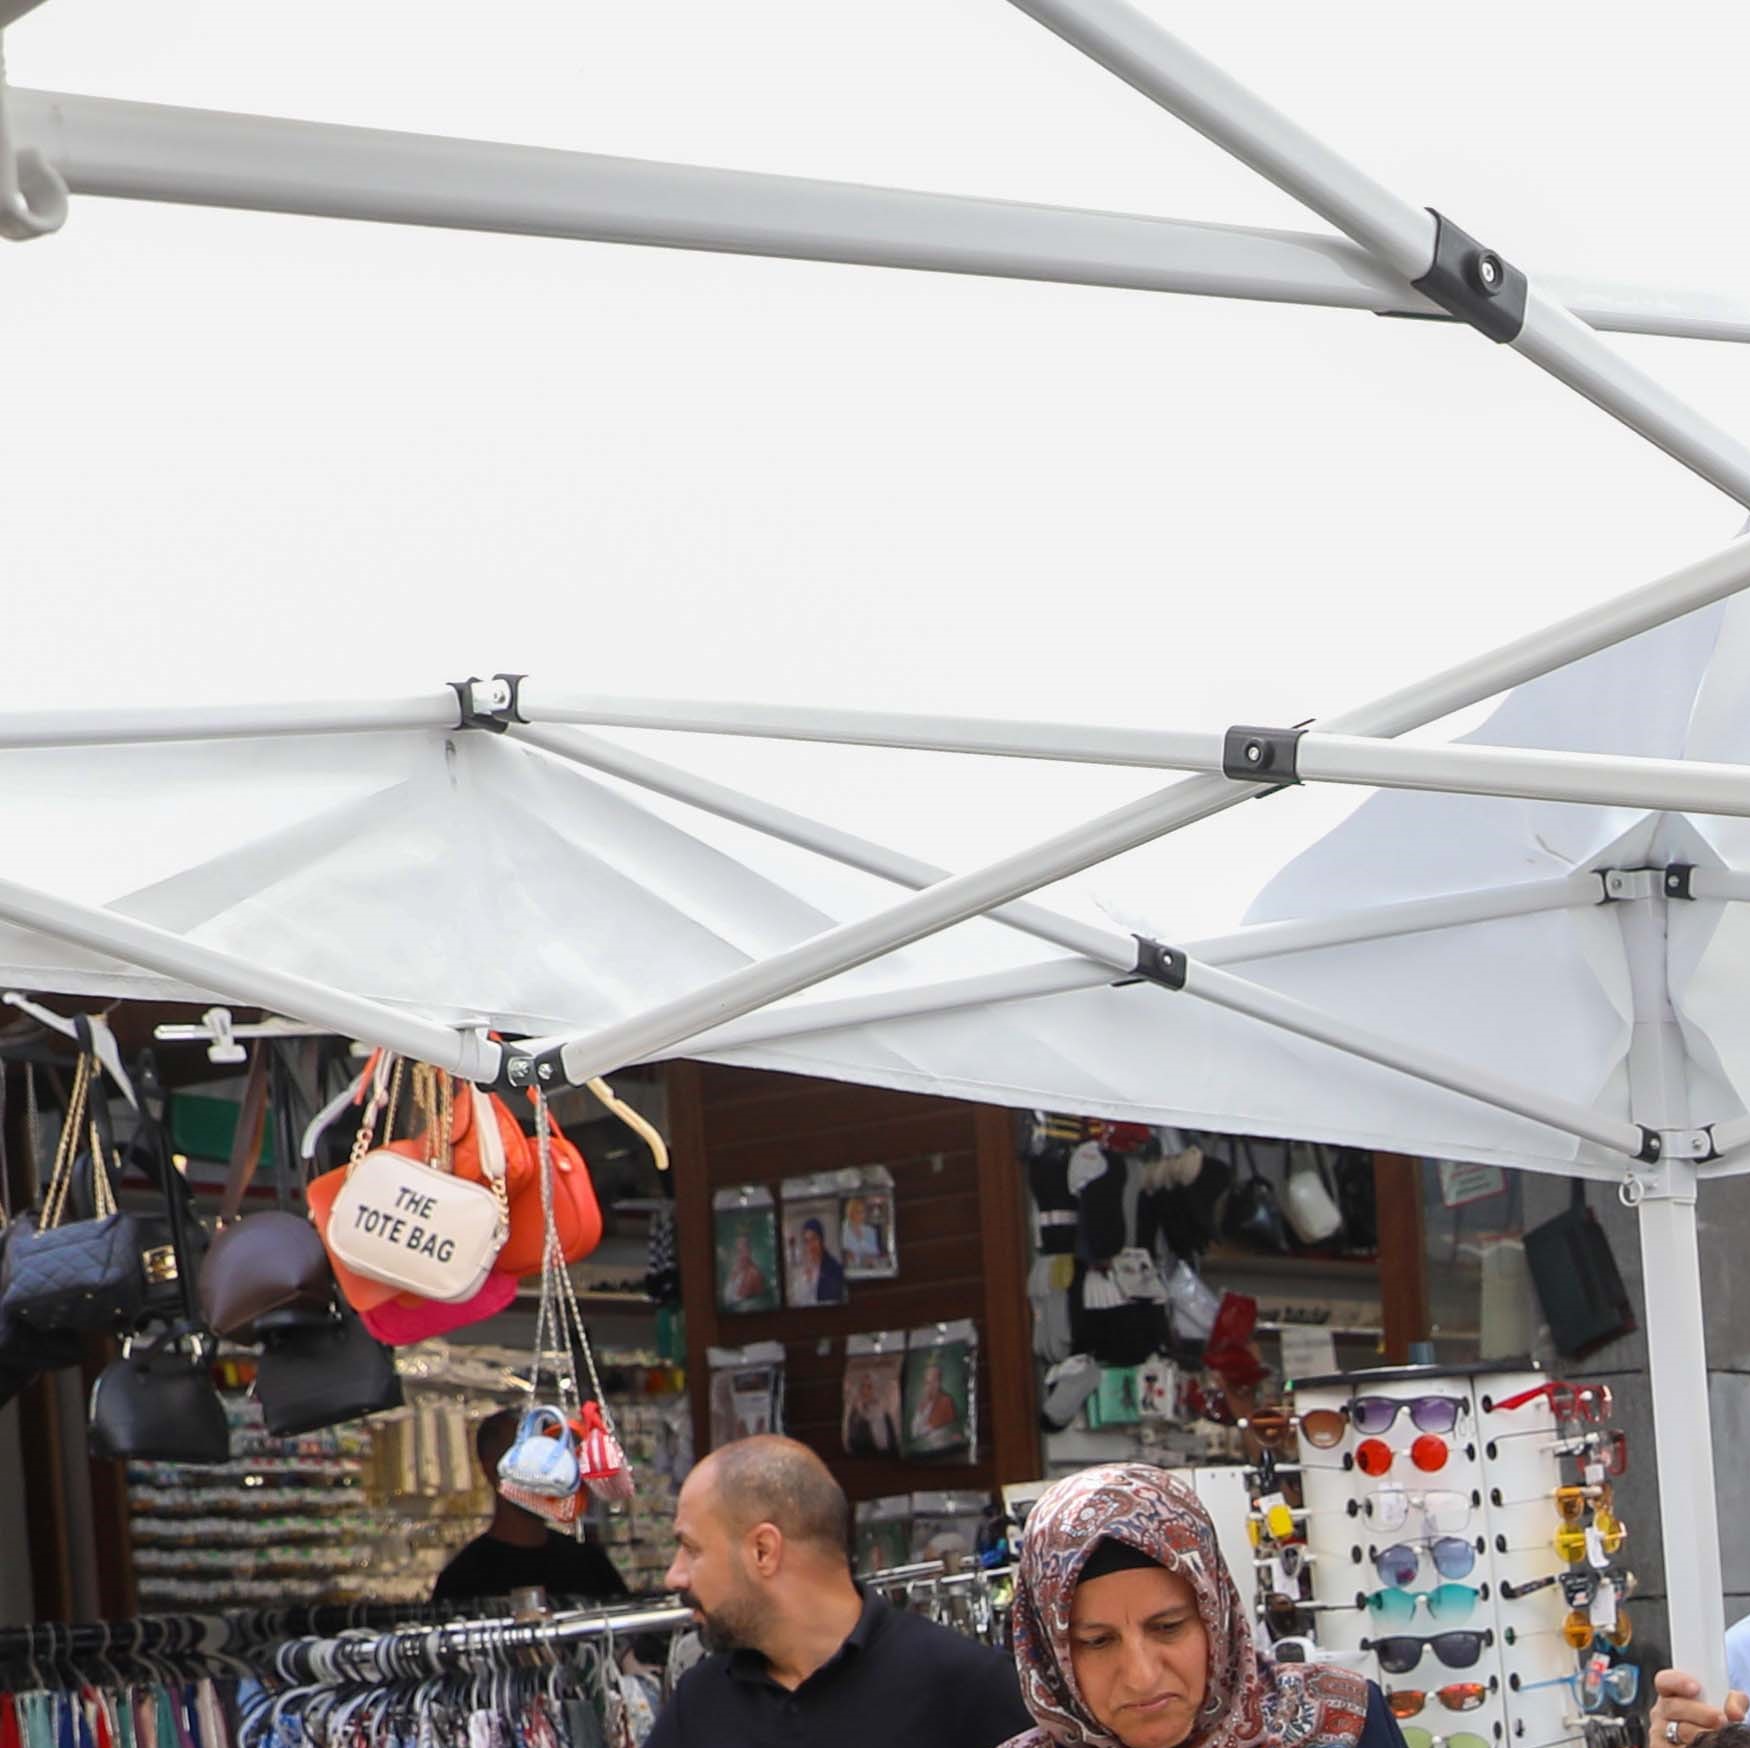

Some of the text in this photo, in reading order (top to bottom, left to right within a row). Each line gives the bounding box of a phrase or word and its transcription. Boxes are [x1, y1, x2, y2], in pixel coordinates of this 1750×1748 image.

[395, 1186, 437, 1221] THE
[355, 1204, 455, 1263] TOTE BAG
